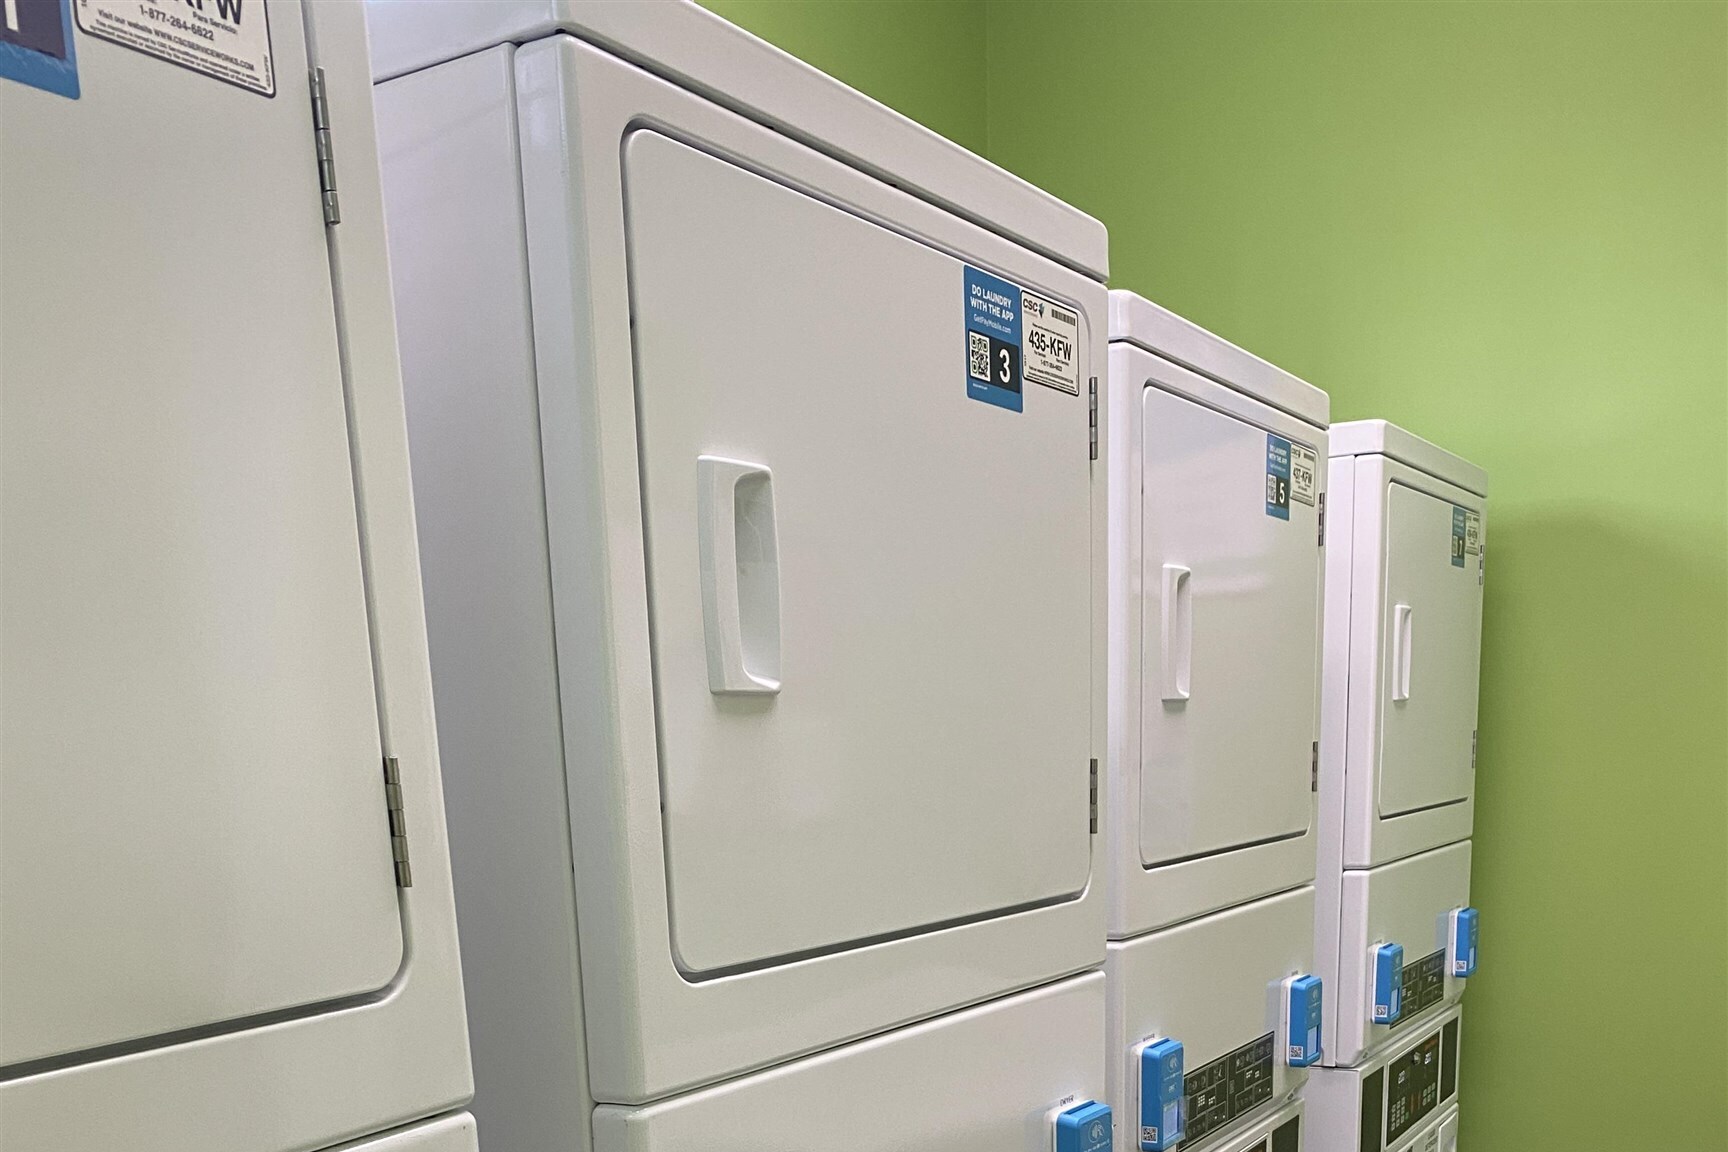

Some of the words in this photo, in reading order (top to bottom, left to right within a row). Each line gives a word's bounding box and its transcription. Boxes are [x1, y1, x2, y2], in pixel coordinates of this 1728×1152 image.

[972, 284, 982, 296] DO
[983, 289, 1012, 308] LAUNDRY
[1023, 298, 1038, 312] CSC
[970, 296, 987, 313] WITH
[988, 304, 1000, 318] THE
[1002, 309, 1014, 322] APP
[1029, 329, 1072, 361] 435-KFW
[999, 349, 1011, 383] 3
[1279, 482, 1285, 504] 5
